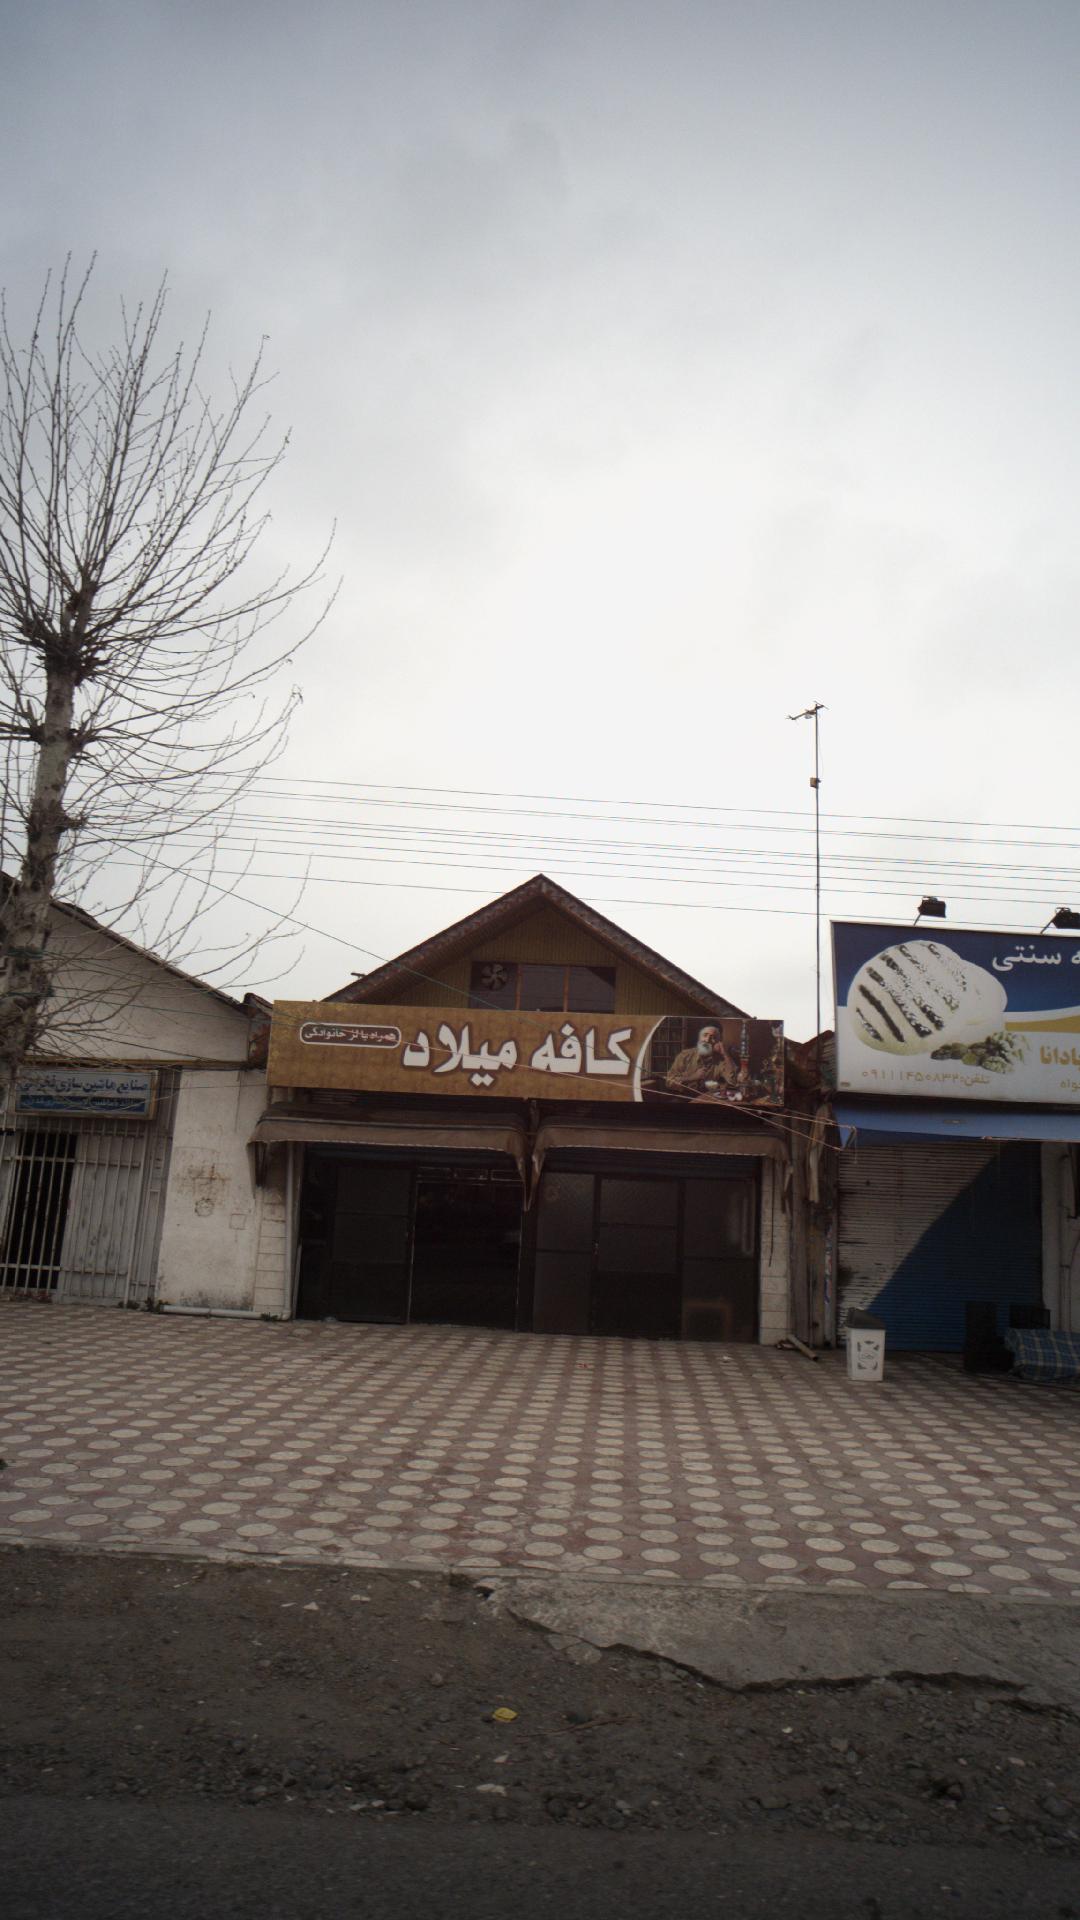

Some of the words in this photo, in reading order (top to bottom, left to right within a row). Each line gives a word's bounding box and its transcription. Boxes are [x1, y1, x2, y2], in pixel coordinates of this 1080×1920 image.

[992, 944, 1062, 972] سنتی
[304, 1026, 346, 1040] خانوادگی
[531, 1022, 632, 1076] کافه
[402, 1023, 518, 1087] میلاد
